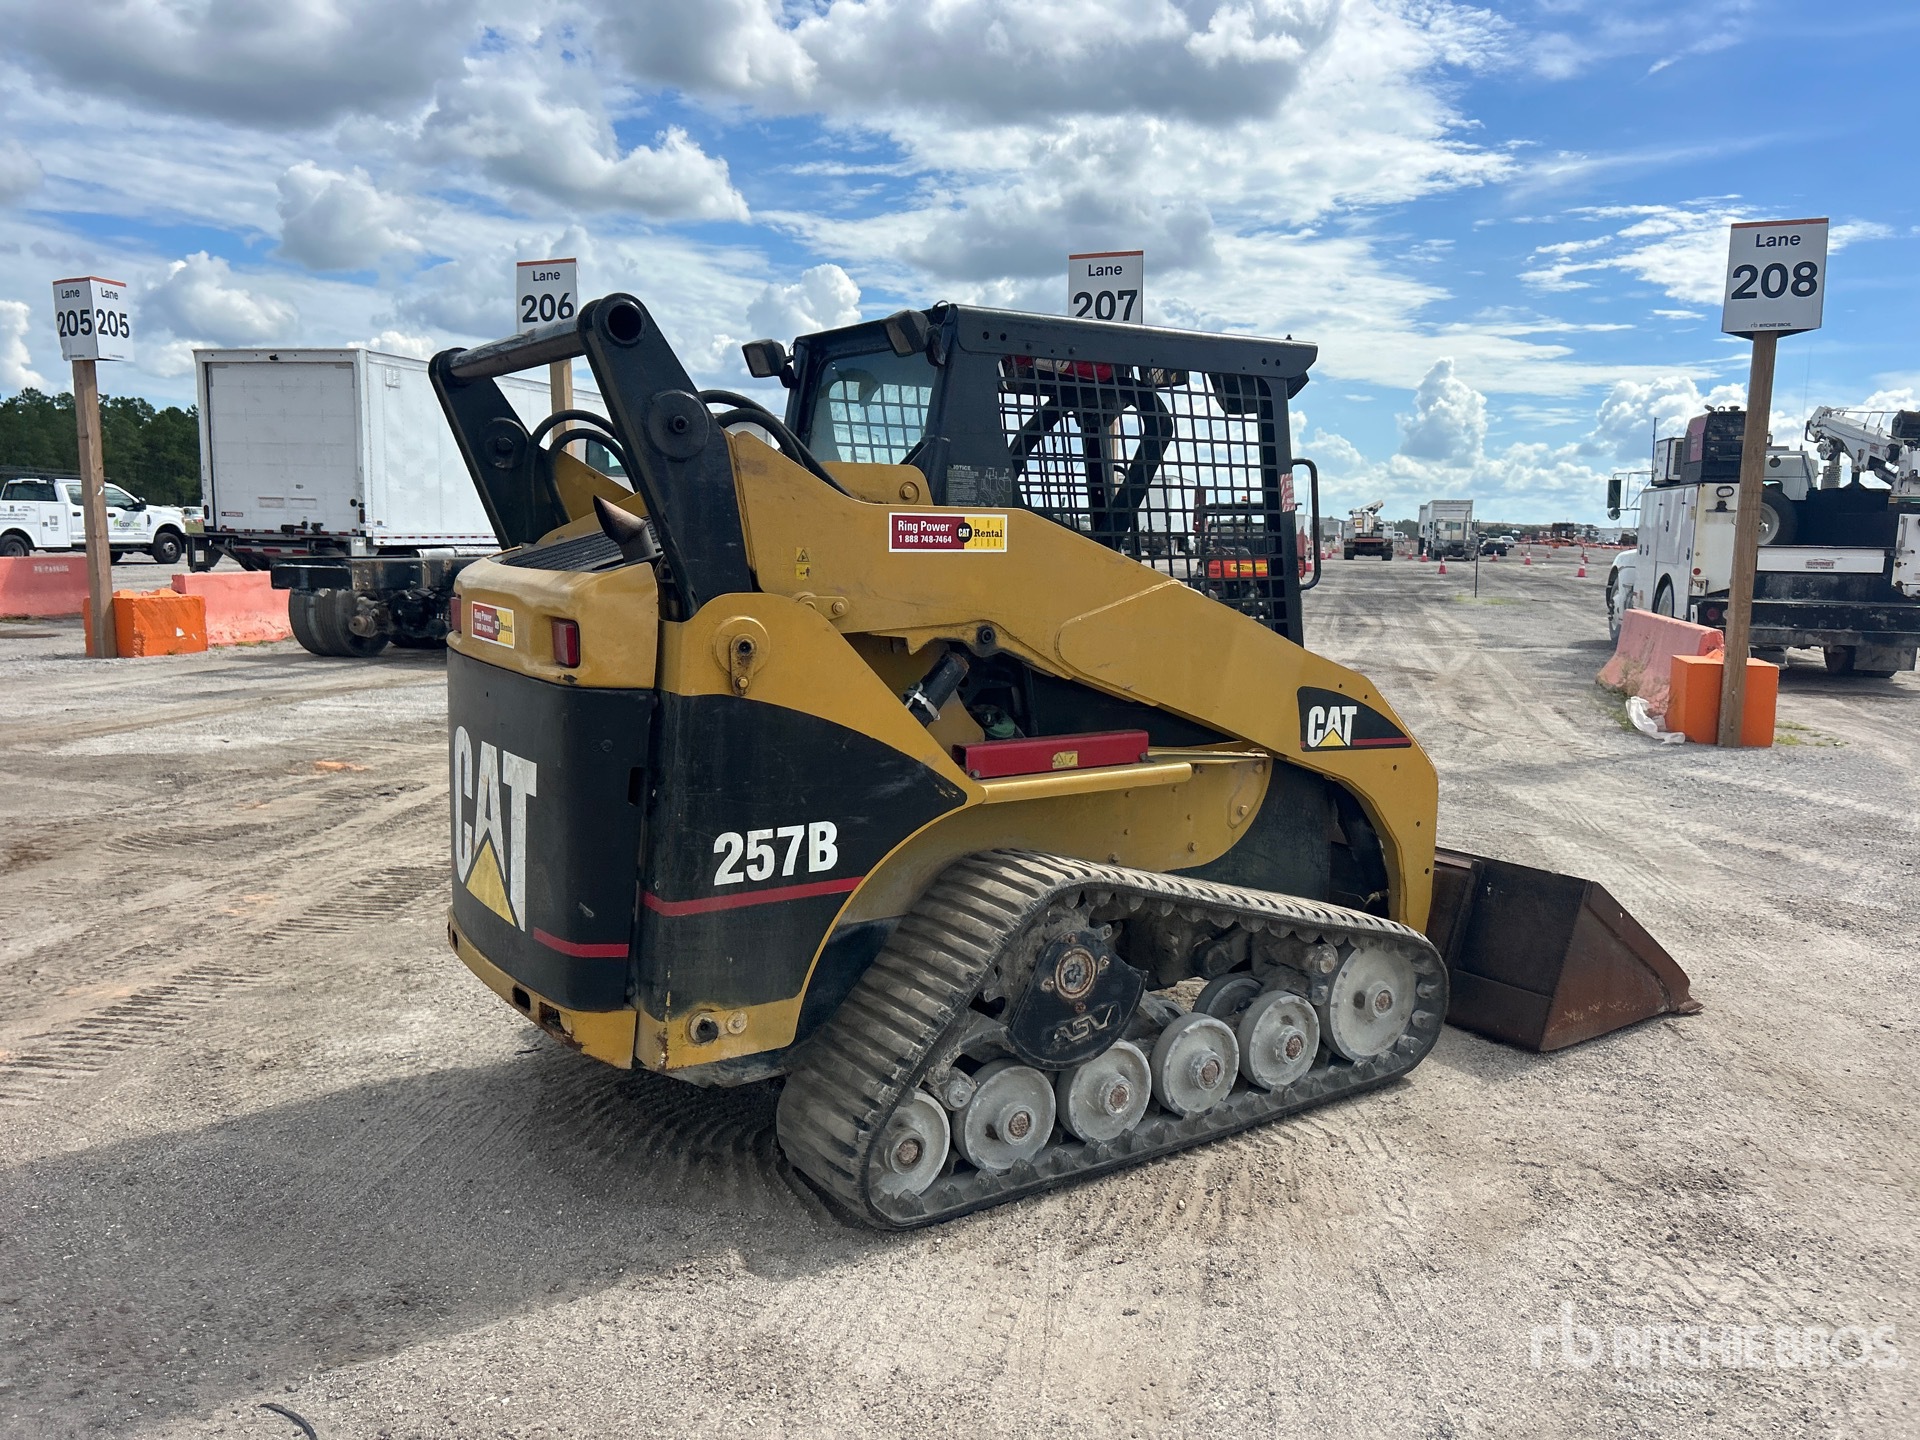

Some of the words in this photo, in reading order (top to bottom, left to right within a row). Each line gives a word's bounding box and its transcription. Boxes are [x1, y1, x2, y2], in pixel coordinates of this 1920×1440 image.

[1755, 233, 1801, 248] Lane
[532, 270, 561, 282] Lane
[1088, 264, 1123, 277] Lane
[1731, 261, 1818, 300] 208
[61, 288, 80, 299] Lane
[100, 287, 119, 301] Lane
[521, 292, 574, 323] 206
[1073, 289, 1138, 321] 207
[57, 309, 93, 338] 205
[96, 308, 130, 339] 205
[898, 520, 919, 533] Ring
[920, 521, 950, 532] Power
[958, 528, 970, 537] CAT
[974, 528, 1003, 538] Rental
[898, 535, 902, 543] 1
[904, 535, 919, 543] 888
[920, 535, 952, 544] 748-7464
[1307, 705, 1358, 748] CAT
[454, 725, 538, 933] CAT
[713, 820, 839, 886] 257B
